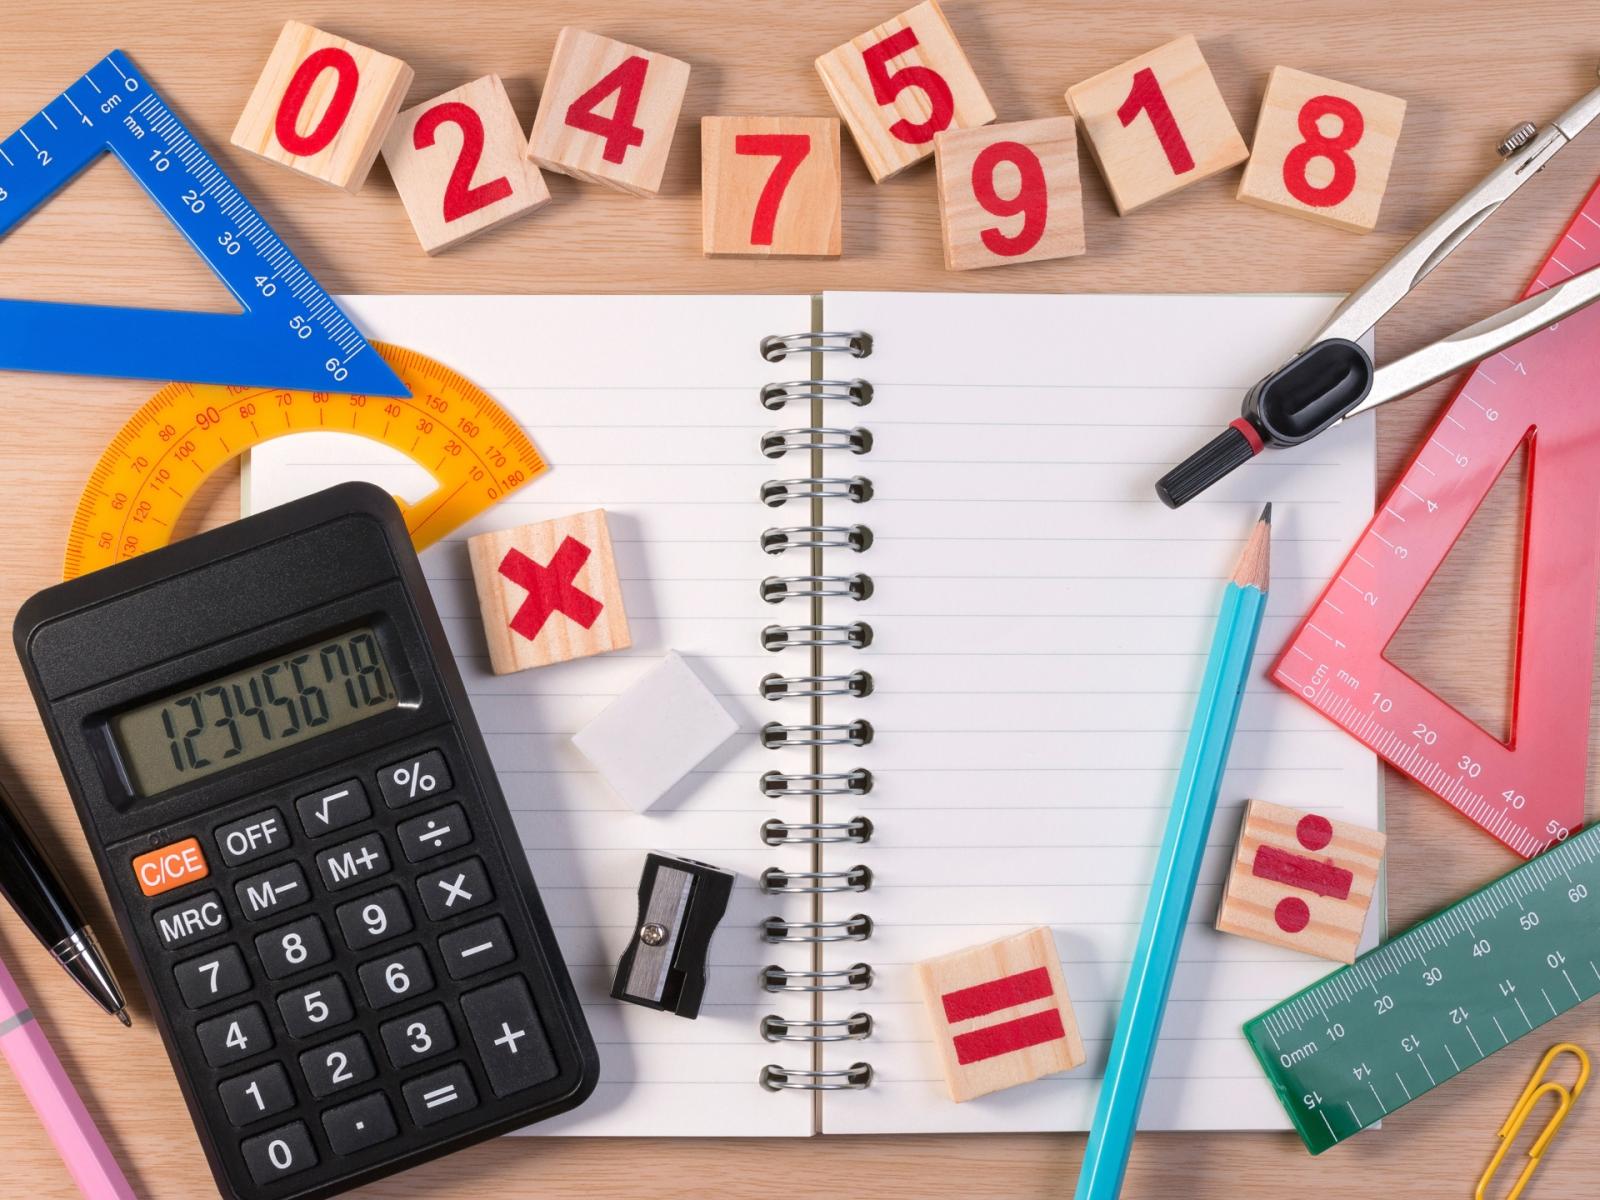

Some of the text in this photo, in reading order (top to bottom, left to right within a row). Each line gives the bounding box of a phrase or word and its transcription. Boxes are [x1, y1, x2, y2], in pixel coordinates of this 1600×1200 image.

[100, 93, 122, 114] cm
[275, 47, 360, 156] 0
[862, 26, 955, 145] 5
[37, 150, 53, 166] 2
[81, 116, 94, 127] 1
[125, 78, 139, 92] 0
[123, 115, 145, 139] mm
[564, 55, 649, 164] 4
[1117, 67, 1195, 176] 1
[413, 101, 513, 223] 2
[1282, 95, 1364, 208] 8
[735, 134, 811, 245] 7
[971, 141, 1048, 257] 9
[149, 149, 348, 381] 10 20 30 40 50 60
[98, 532, 113, 549] 50
[112, 492, 128, 510] 60
[131, 456, 148, 473] 70
[158, 424, 176, 442] 80
[196, 407, 220, 430] 90
[426, 394, 448, 413] 150
[457, 418, 480, 438] 160
[485, 446, 506, 467] 170
[502, 470, 525, 490] 180
[133, 501, 151, 523] 120
[151, 469, 170, 490] 110
[175, 441, 196, 461] 100
[240, 403, 256, 419] 80
[275, 393, 292, 408] 70
[350, 394, 366, 407] 50
[384, 404, 400, 418] 40
[416, 418, 433, 434] 30
[444, 440, 461, 456] 20
[469, 466, 484, 481] 10
[487, 487, 498, 500] 0
[1303, 363, 1527, 698] 0 1 2 3 4 5 6 7
[1312, 663, 1329, 685] cm
[1336, 670, 1360, 689] mm
[1372, 692, 1569, 841] 10 20 30 40 50
[227, 818, 277, 855] OFF
[140, 847, 202, 887] C/CE
[327, 847, 379, 882] M+
[160, 902, 222, 942] MRC
[362, 904, 387, 935] 9
[281, 933, 308, 964] 8
[198, 961, 221, 993] 7
[385, 963, 410, 994] 6
[1280, 884, 1588, 1069] 0mm 10 20 30 40 50 60
[304, 991, 330, 1023] 5
[225, 1021, 248, 1050] 4
[406, 1022, 432, 1053] 3
[1303, 951, 1566, 1109] 10 11 12 13 14 15
[326, 1051, 353, 1083] 2
[245, 1081, 266, 1111] 1
[268, 1139, 293, 1170] 0
